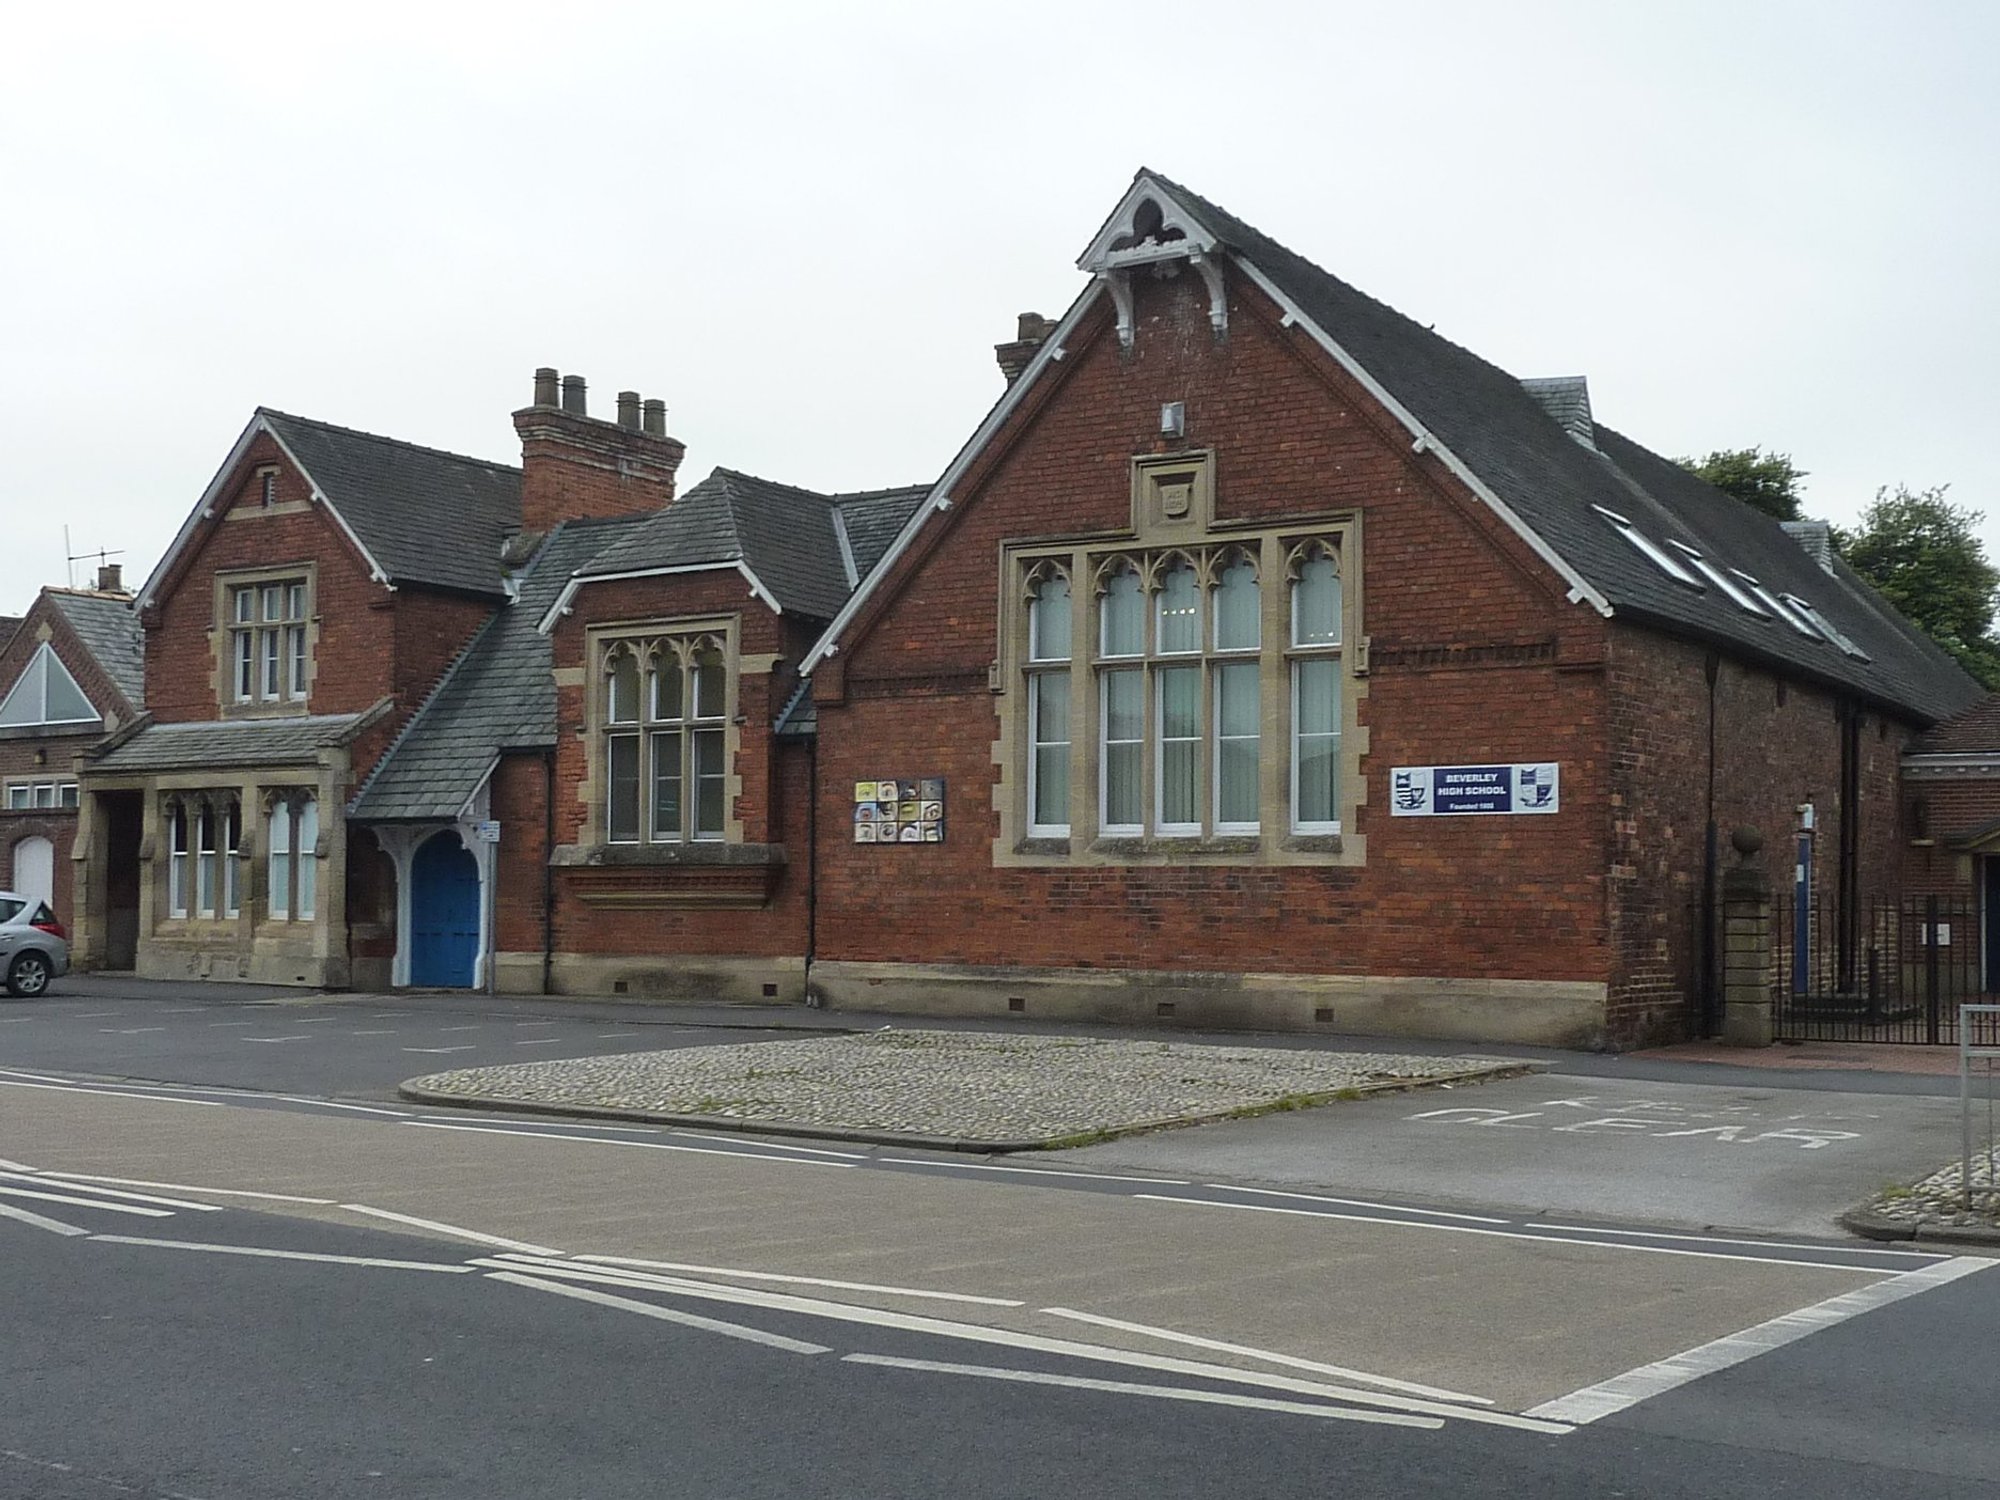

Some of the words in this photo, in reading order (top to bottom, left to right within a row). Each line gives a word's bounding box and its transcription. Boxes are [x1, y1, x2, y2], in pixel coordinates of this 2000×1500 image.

[1446, 774, 1499, 783] BEVERLEY
[1438, 787, 1464, 796] HIGH
[1465, 786, 1507, 795] SCHOOL
[1402, 1107, 1862, 1150] CLEAR
